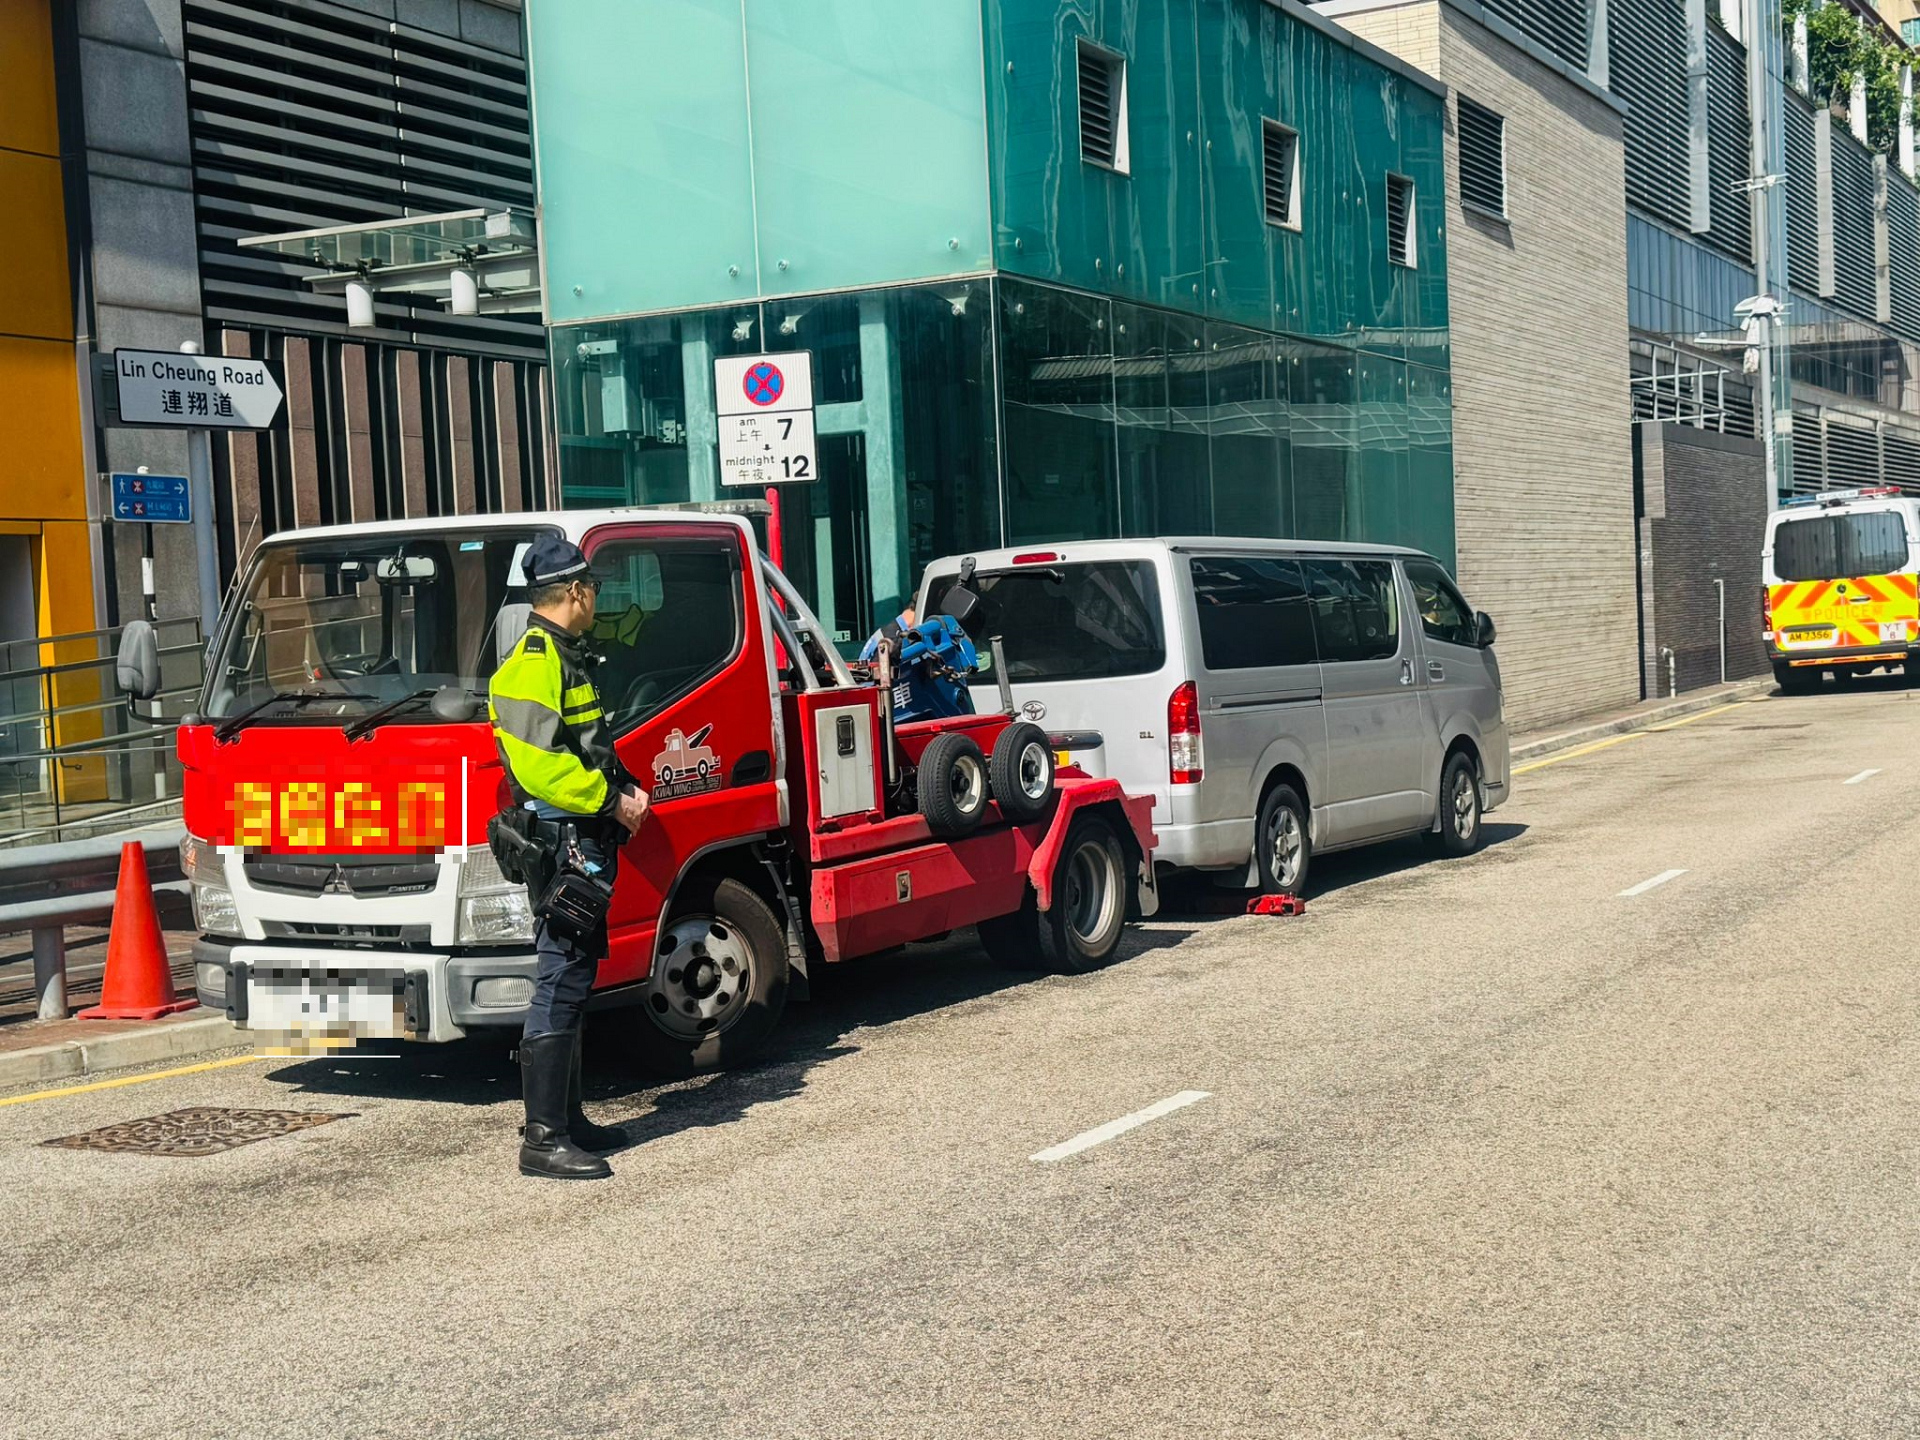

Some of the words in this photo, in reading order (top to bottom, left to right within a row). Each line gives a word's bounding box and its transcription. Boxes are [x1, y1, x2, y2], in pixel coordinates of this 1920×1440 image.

[121, 359, 146, 378] Lin
[151, 361, 217, 386] Cheung
[222, 366, 264, 386] Road
[161, 389, 235, 418] 連翔道
[739, 418, 757, 427] am
[776, 418, 793, 441] 7
[736, 429, 763, 443] 上午
[725, 455, 776, 467] midnight
[780, 454, 810, 478] 12
[738, 468, 764, 481] 午夜
[1814, 605, 1870, 621] POLICE
[1789, 632, 1802, 642] AM
[1805, 631, 1830, 641] 7356
[892, 682, 913, 709] 車
[654, 785, 673, 800] KWAI
[673, 781, 692, 796] WING
